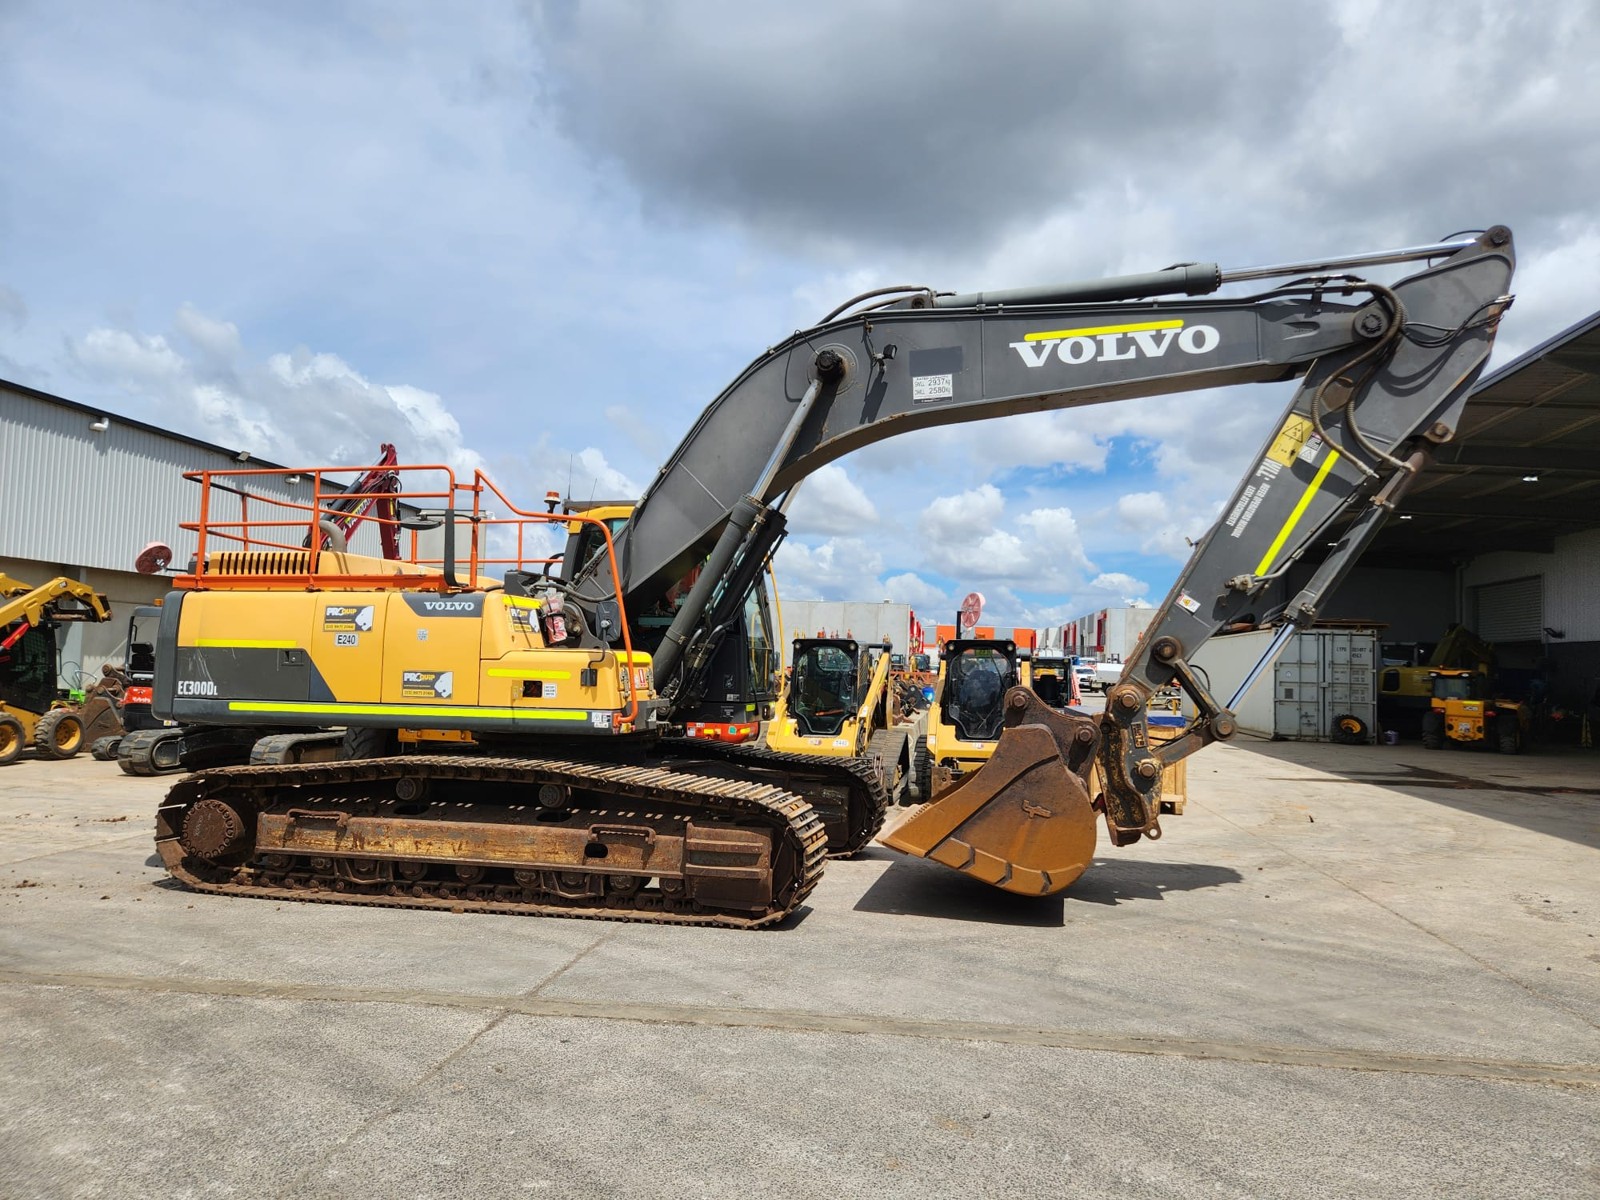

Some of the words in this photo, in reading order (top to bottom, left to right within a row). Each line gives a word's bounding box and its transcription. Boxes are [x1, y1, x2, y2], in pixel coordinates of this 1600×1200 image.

[1009, 325, 1220, 368] VOLVO
[928, 378, 945, 386] 2937
[929, 386, 945, 395] 2580
[423, 601, 475, 611] VOLVO
[337, 635, 356, 644] E240
